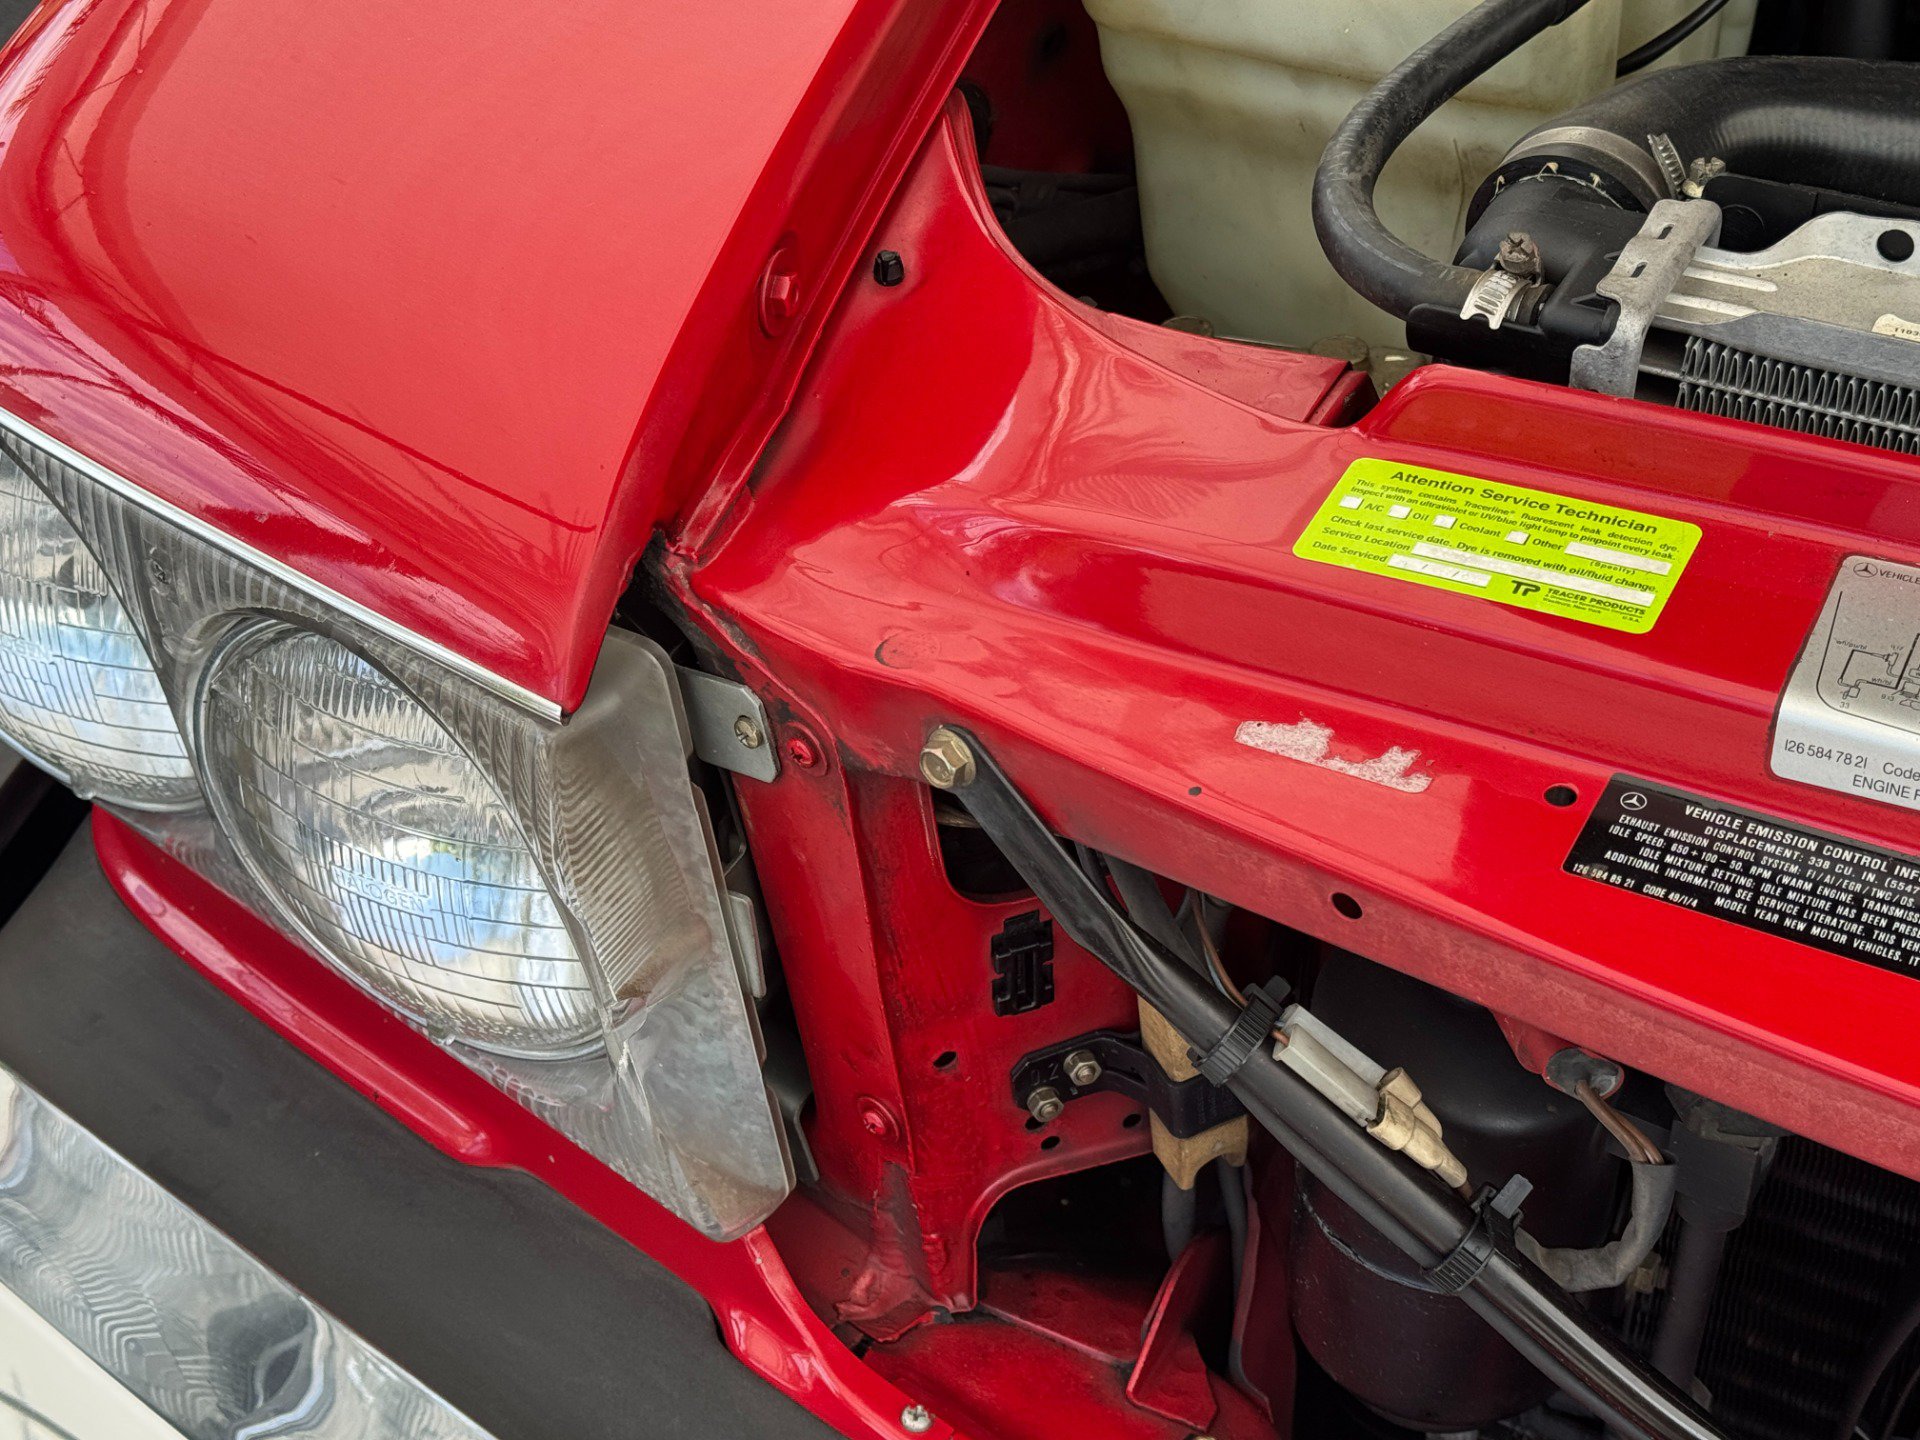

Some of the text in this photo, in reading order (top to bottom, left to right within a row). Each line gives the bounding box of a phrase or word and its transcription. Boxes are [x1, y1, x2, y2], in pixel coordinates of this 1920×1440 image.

[1350, 486, 1384, 498] Inspect
[1385, 492, 1405, 502] with
[1419, 499, 1468, 515] ultraviolet
[1468, 509, 1480, 517] or
[1480, 512, 1517, 527] UV/blue
[1519, 520, 1542, 533] light
[1542, 526, 1568, 538] lamp
[1569, 531, 1579, 539] to
[1580, 534, 1621, 550] pinpoint
[1622, 543, 1651, 556] every
[1651, 549, 1676, 560] leak.
[1356, 479, 1375, 488] This
[1381, 484, 1413, 495] system
[1418, 491, 1457, 505] contains
[1521, 512, 1575, 529] fluorescent
[1580, 525, 1602, 536] leak
[1608, 531, 1653, 546] detection
[1659, 542, 1680, 553] dye.
[1364, 503, 1564, 551] A/C Oil Coolant Other
[1390, 471, 1658, 534] Attention Service Technician
[1312, 541, 1389, 562] Date Serviced
[1322, 526, 1411, 551] Service Location
[1331, 515, 1659, 593] Check last service date. Dye is removed with oil/fluid change.
[1511, 580, 1541, 596] TP
[1547, 588, 1587, 602] TRACER
[1590, 597, 1646, 615] PRODUCTS
[1879, 569, 1920, 585] VEHICLE
[1784, 739, 1920, 781] 126 584 78 21 Code
[1852, 774, 1911, 799] ENGINE
[1608, 825, 1631, 838] IDLE
[1634, 832, 1667, 849] SPEED:
[1670, 843, 1690, 855] 650
[1700, 852, 1718, 864] 100
[1749, 866, 1772, 880] RPM
[1775, 874, 1813, 891] (WARM
[1816, 885, 1855, 905] ENGINE.
[1618, 814, 1660, 833] EXHAUST
[1663, 827, 1710, 848] EMISSION
[1713, 841, 1756, 862] CONTROL
[1760, 855, 1802, 876] SYSTEM:
[1684, 804, 1920, 882] VEHICLE EMISSION CONTROL INF
[1703, 826, 1920, 895] DISPLACEMENT: 338 CU. IN. (5547
[333, 866, 425, 913] HALOGEN
[1573, 863, 1589, 875] 126
[1591, 868, 1609, 881] 584
[1624, 878, 1635, 889] 21
[1642, 884, 1668, 898] CODE
[1668, 892, 1699, 908] 49/1/4
[1604, 850, 1920, 953] ADDITIONAL INFORMATION SEE SERVICE LITERATURE. THIS VEH
[1638, 847, 1661, 860] IDLE
[1663, 854, 1708, 875] MIXTURE
[1711, 868, 1756, 889] SETTING:
[1760, 883, 1783, 897] IDLE
[1786, 890, 1833, 911] MIXTURE
[1836, 905, 1858, 919] HAS
[1861, 912, 1889, 928] BEEN
[1714, 897, 1920, 966] MODEL YEAR NEW MOTOR VEHICLES. IT
